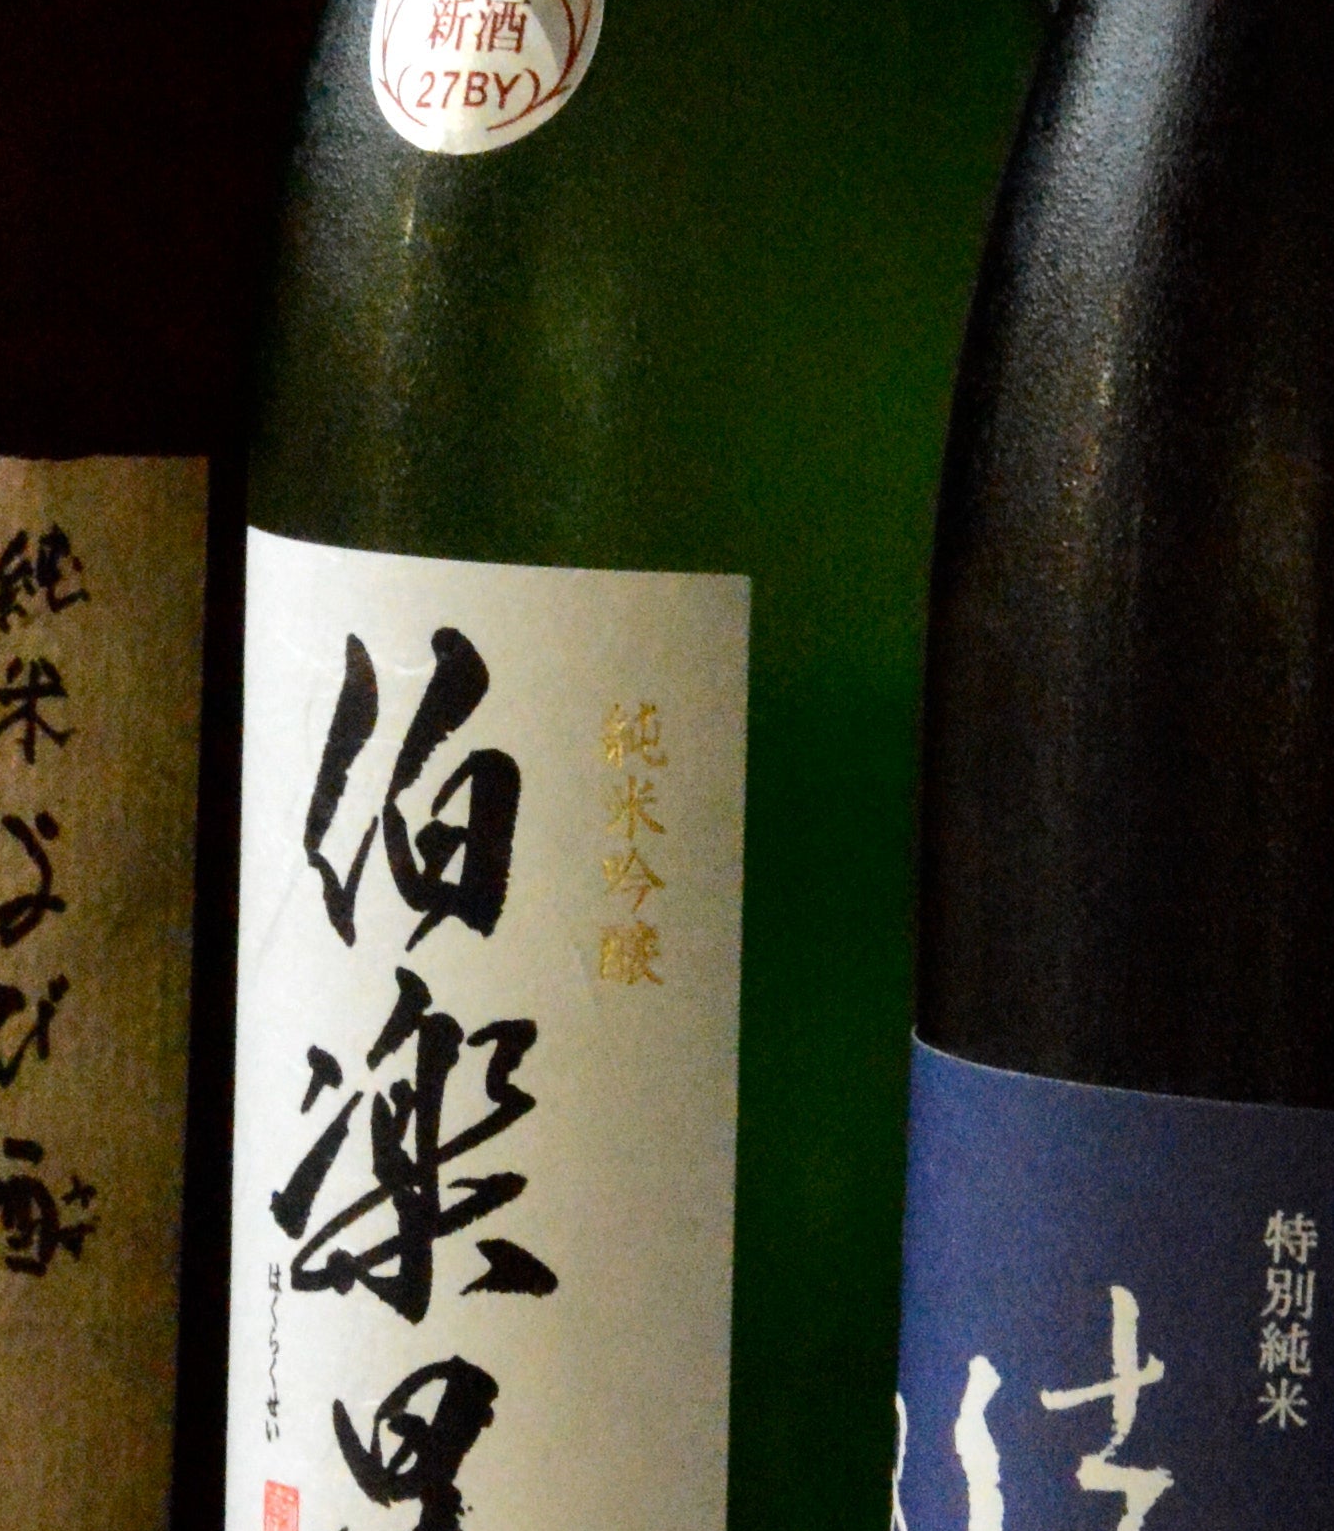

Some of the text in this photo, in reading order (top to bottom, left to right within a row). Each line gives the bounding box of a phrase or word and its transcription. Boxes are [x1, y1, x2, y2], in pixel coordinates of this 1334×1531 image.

[396, 65, 541, 111] (27BY)
[600, 701, 668, 987] 純米吟醸
[1256, 1208, 1320, 1431] 特別純米
